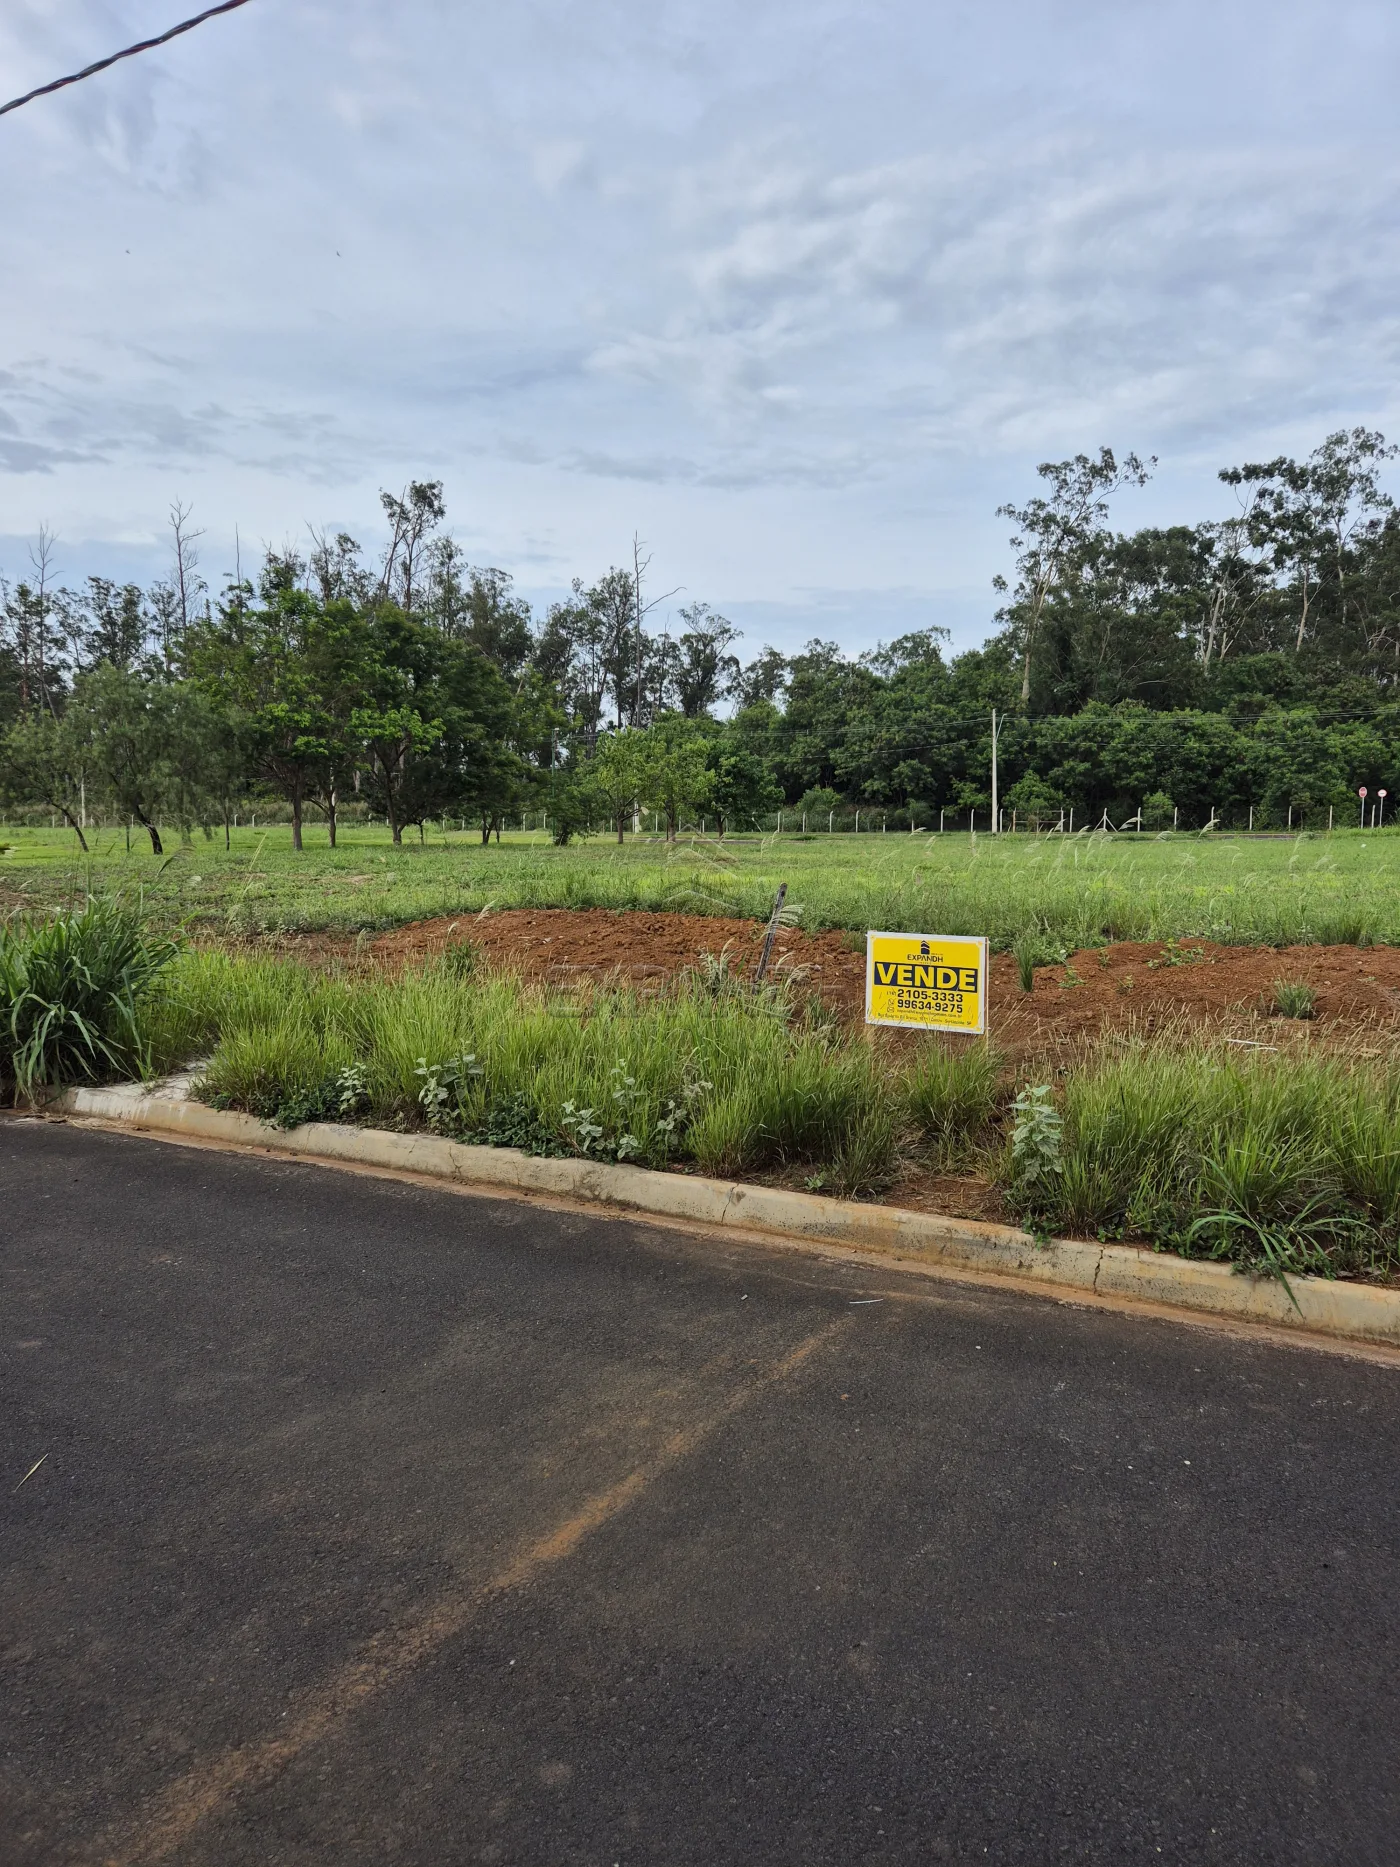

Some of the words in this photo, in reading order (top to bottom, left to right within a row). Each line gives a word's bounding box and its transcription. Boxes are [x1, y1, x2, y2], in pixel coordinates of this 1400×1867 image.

[907, 953, 943, 962] EXPANDH
[876, 963, 976, 991] VENDE
[897, 988, 963, 1003] 2105-3333
[897, 999, 963, 1013] 99634-9275
